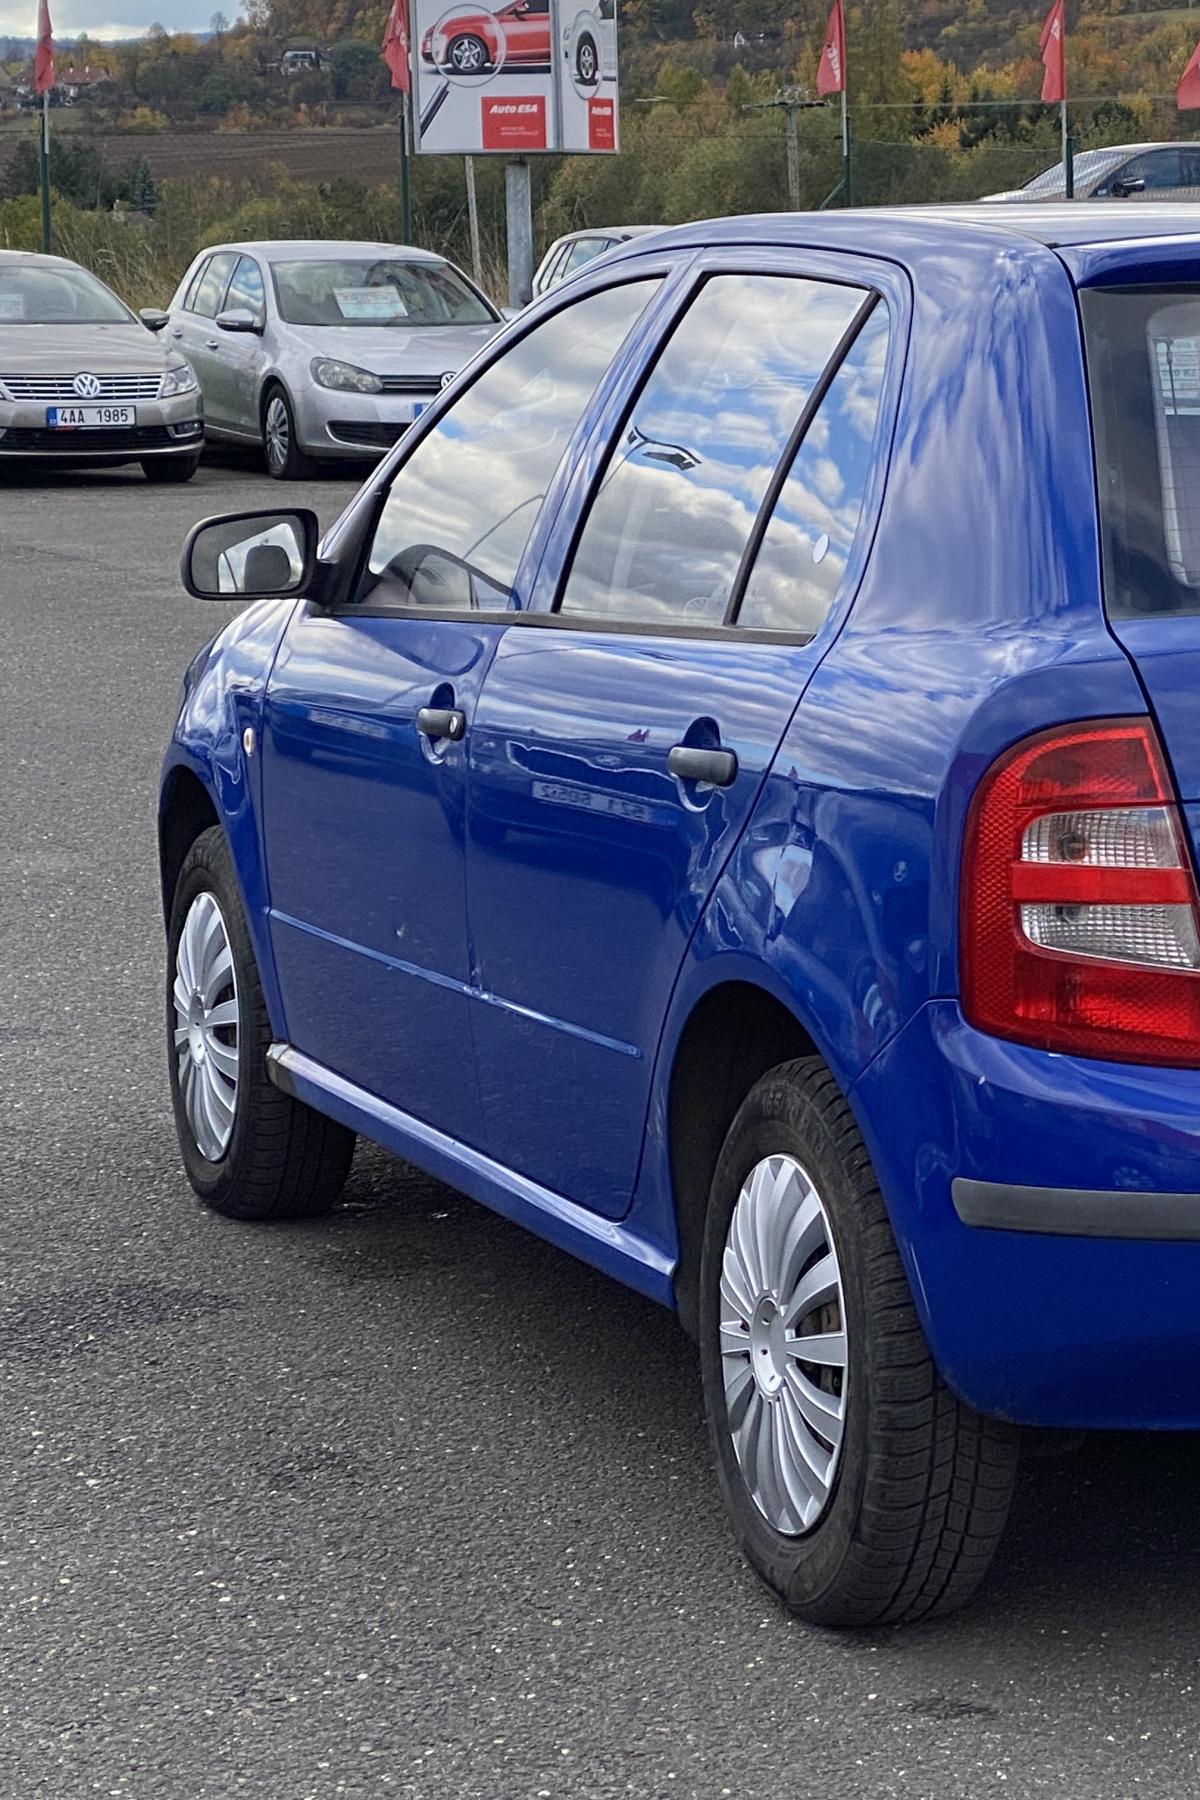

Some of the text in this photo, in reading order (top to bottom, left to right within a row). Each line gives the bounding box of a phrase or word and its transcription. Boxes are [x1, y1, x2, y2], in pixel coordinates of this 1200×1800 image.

[489, 104, 538, 114] Auto ESA
[60, 410, 85, 424] 4AA
[97, 409, 128, 423] 1985
